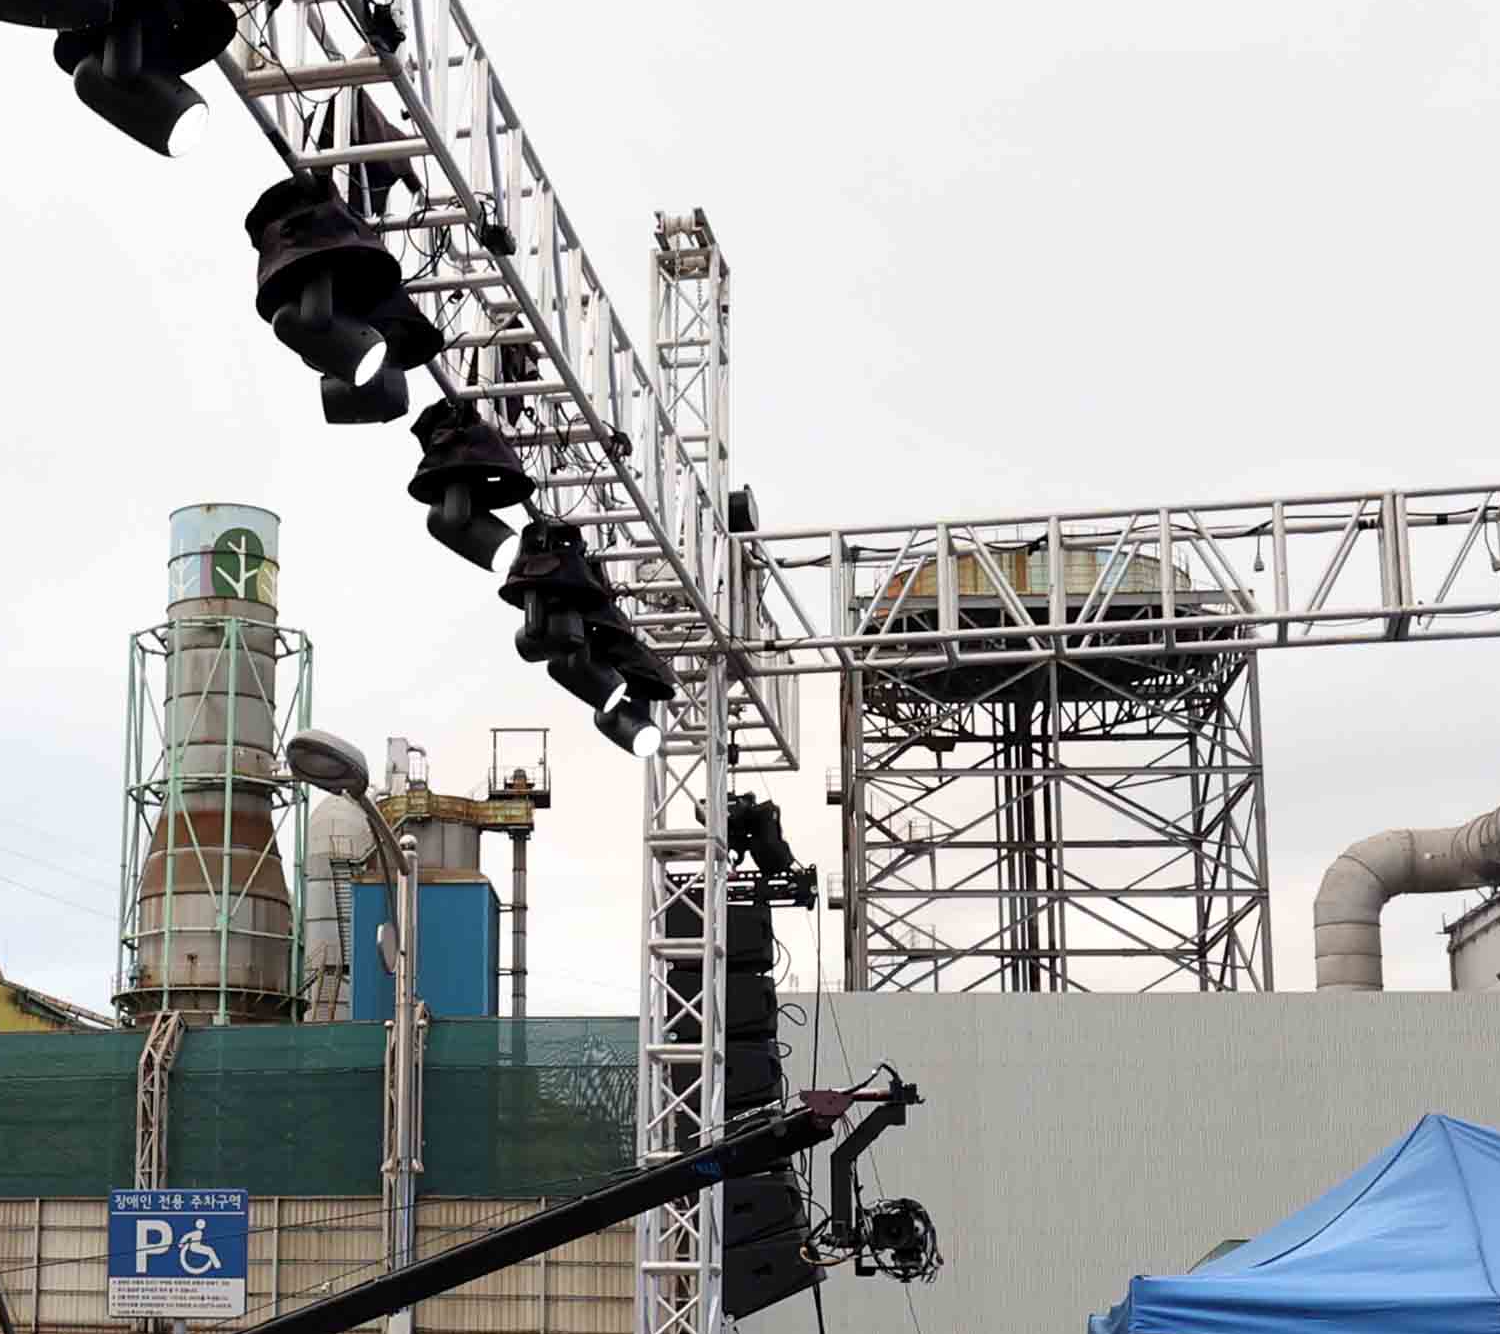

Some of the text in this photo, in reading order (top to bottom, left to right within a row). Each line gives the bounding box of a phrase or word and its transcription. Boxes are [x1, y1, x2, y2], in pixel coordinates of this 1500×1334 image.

[114, 1193, 241, 1210] 장애인 전용 주차구역
[135, 1219, 173, 1274] P
